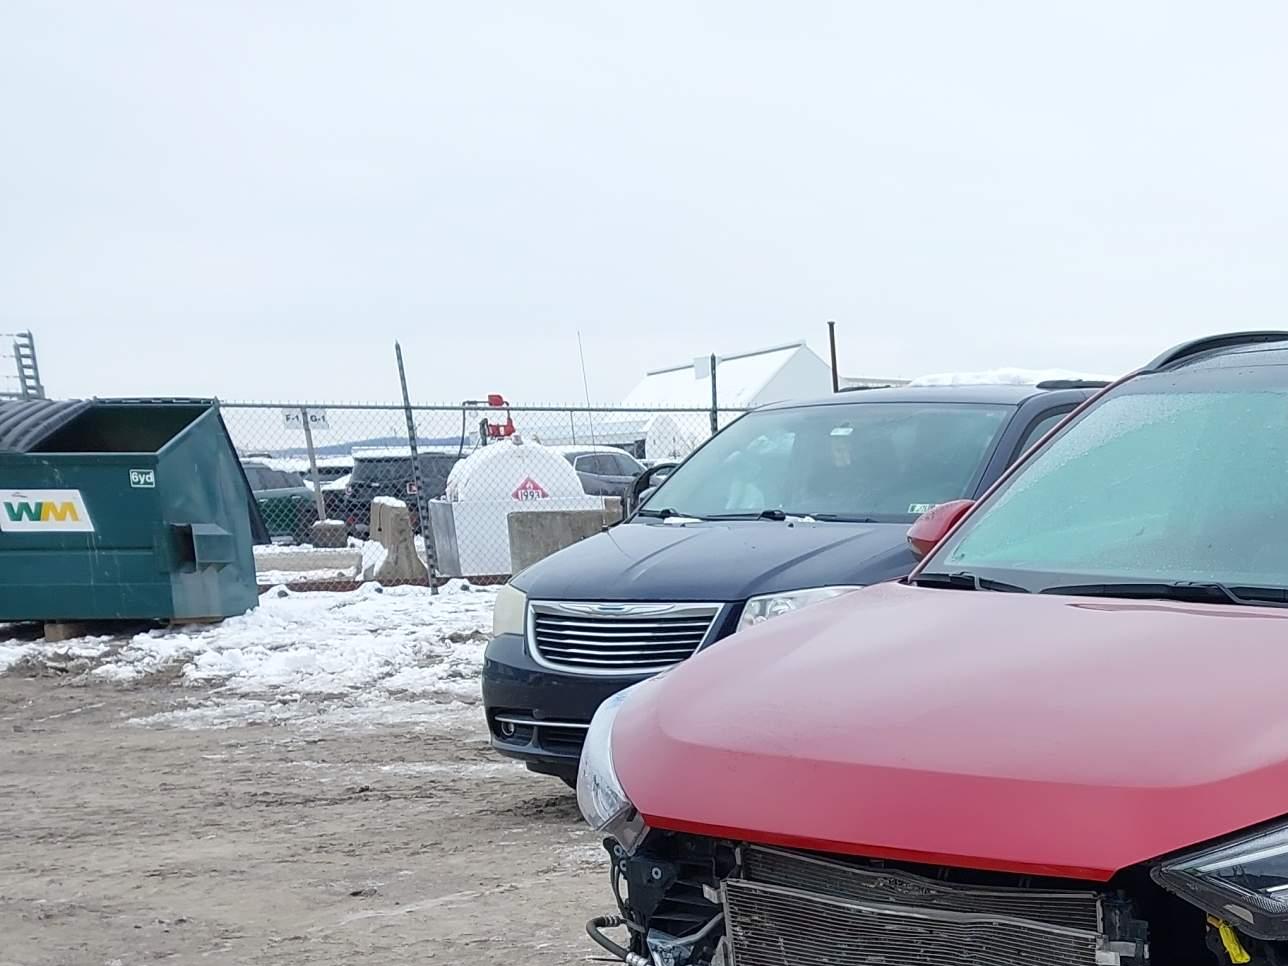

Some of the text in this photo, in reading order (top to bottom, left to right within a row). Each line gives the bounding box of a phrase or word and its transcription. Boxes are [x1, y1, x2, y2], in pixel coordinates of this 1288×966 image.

[285, 414, 300, 422] F-1
[131, 471, 154, 485] 6yd
[4, 501, 80, 522] WM
